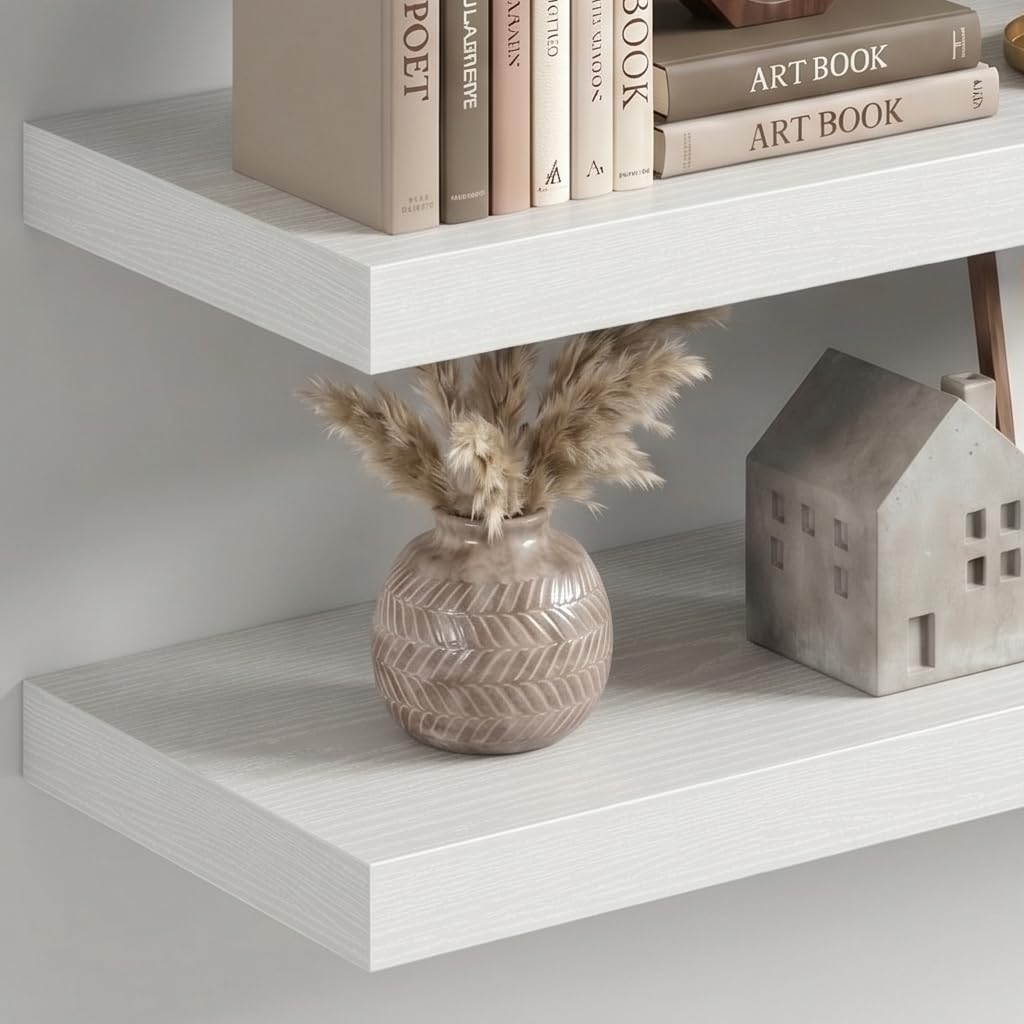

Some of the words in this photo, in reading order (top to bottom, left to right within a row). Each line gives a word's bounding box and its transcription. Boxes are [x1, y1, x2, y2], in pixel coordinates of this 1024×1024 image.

[403, 0, 429, 101] POET
[749, 59, 807, 93] ART
[812, 44, 889, 81] BOOK
[749, 114, 811, 152] ART
[817, 97, 904, 138] BOOK
